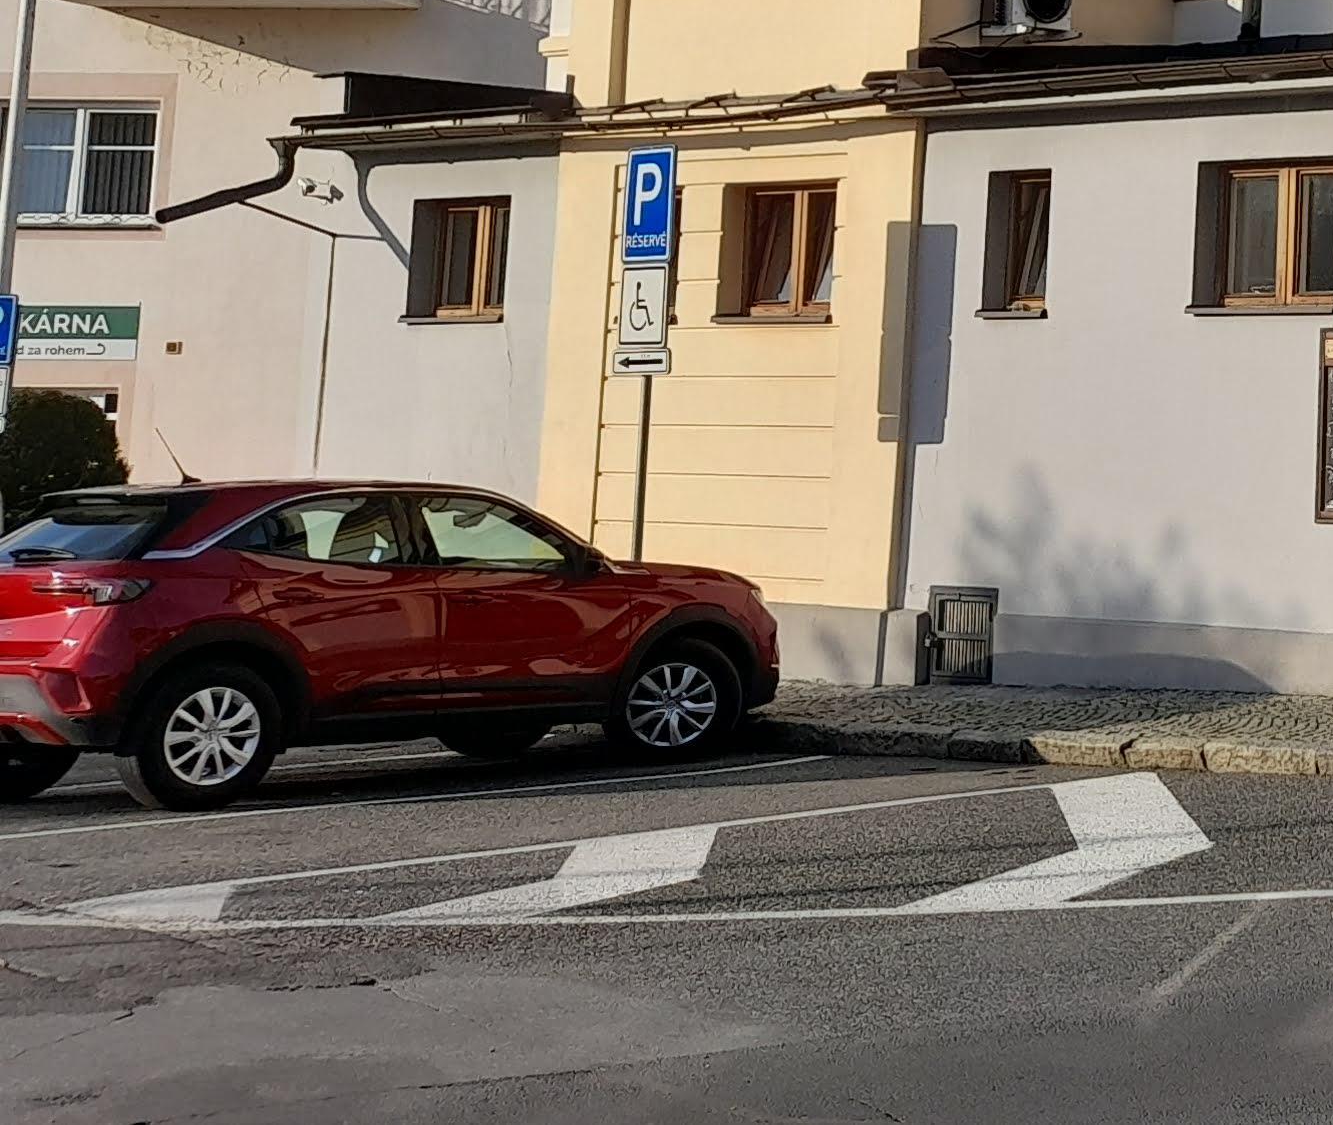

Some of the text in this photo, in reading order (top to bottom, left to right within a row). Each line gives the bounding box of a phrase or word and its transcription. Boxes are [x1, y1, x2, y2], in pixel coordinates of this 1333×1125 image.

[633, 162, 663, 226] P
[626, 231, 667, 248] RÉSERVÉ
[19, 308, 110, 335] KÁRNA
[28, 347, 42, 356] za
[44, 345, 86, 356] rohem
